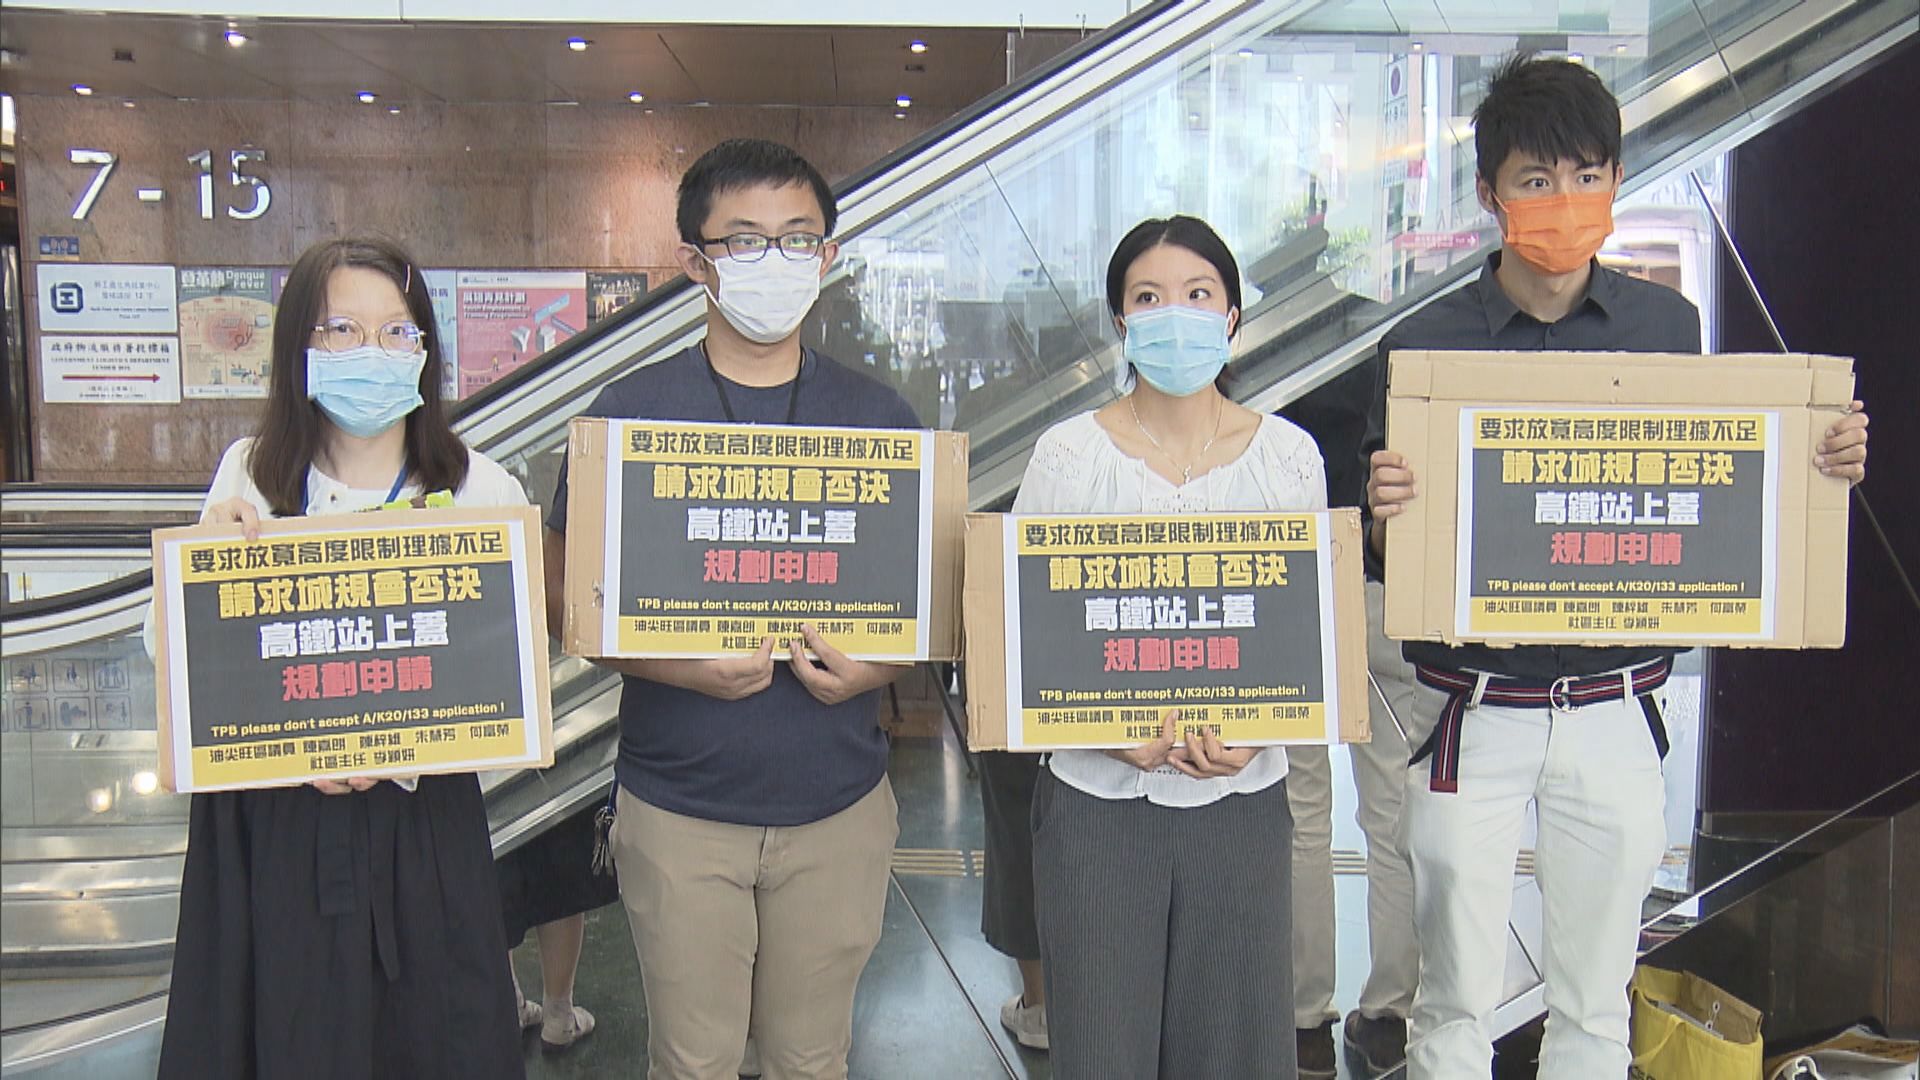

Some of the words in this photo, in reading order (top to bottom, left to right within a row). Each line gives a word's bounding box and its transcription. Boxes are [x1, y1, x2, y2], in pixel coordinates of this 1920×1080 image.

[69, 148, 119, 220] 7
[187, 148, 271, 220] 15
[226, 270, 265, 282] Dengue
[234, 279, 265, 289] Fever
[631, 430, 914, 461] 要求放寬高度限制理據不足
[1480, 417, 1757, 441] 要求放寬高度限制理據不足
[653, 464, 891, 504] 請求城規會否決
[1502, 451, 1735, 485] 請求城規會否決
[1534, 491, 1700, 525] 高鐵站上蓋
[687, 507, 856, 544] 高鐵站上蓋
[1025, 519, 1309, 547] 要求放寬高度限制理據不足
[190, 531, 504, 573] 要求放寬高度限制理據不足
[1550, 532, 1682, 565] 規劃申請
[703, 550, 838, 584] 規劃申請
[1048, 553, 1288, 591] 請求城規會否決
[217, 567, 482, 619] 請求城規會否決
[1487, 580, 1509, 591] TPB
[1512, 580, 1546, 592] please
[1549, 580, 1575, 591] don't
[1578, 581, 1613, 592] accept
[1616, 580, 1675, 593] A/K20/133
[1678, 581, 1738, 593] application
[637, 598, 660, 610] TPB
[663, 598, 699, 611] please
[702, 599, 730, 610] don't
[732, 600, 769, 612] accept
[772, 600, 832, 612] A/K20/133
[834, 601, 894, 613] application
[1084, 594, 1256, 631] 高鐵站上蓋
[1568, 616, 1616, 629] 社區主任
[258, 611, 449, 659] 高鐵站上蓋
[1103, 637, 1240, 672] 規劃申請
[281, 655, 433, 702] 規劃申請
[1039, 690, 1063, 701] TPB
[1066, 690, 1101, 703] please
[1104, 688, 1132, 700] don't
[1135, 689, 1172, 701] accept
[1174, 686, 1235, 699] A/K20/133
[1238, 685, 1299, 699] application
[211, 725, 238, 738] TPB
[241, 723, 280, 737] please
[284, 718, 316, 732] don't
[318, 713, 360, 727] accept
[363, 707, 429, 725] A/K20/133
[432, 702, 498, 719] application
[310, 751, 366, 770] 社區主任
